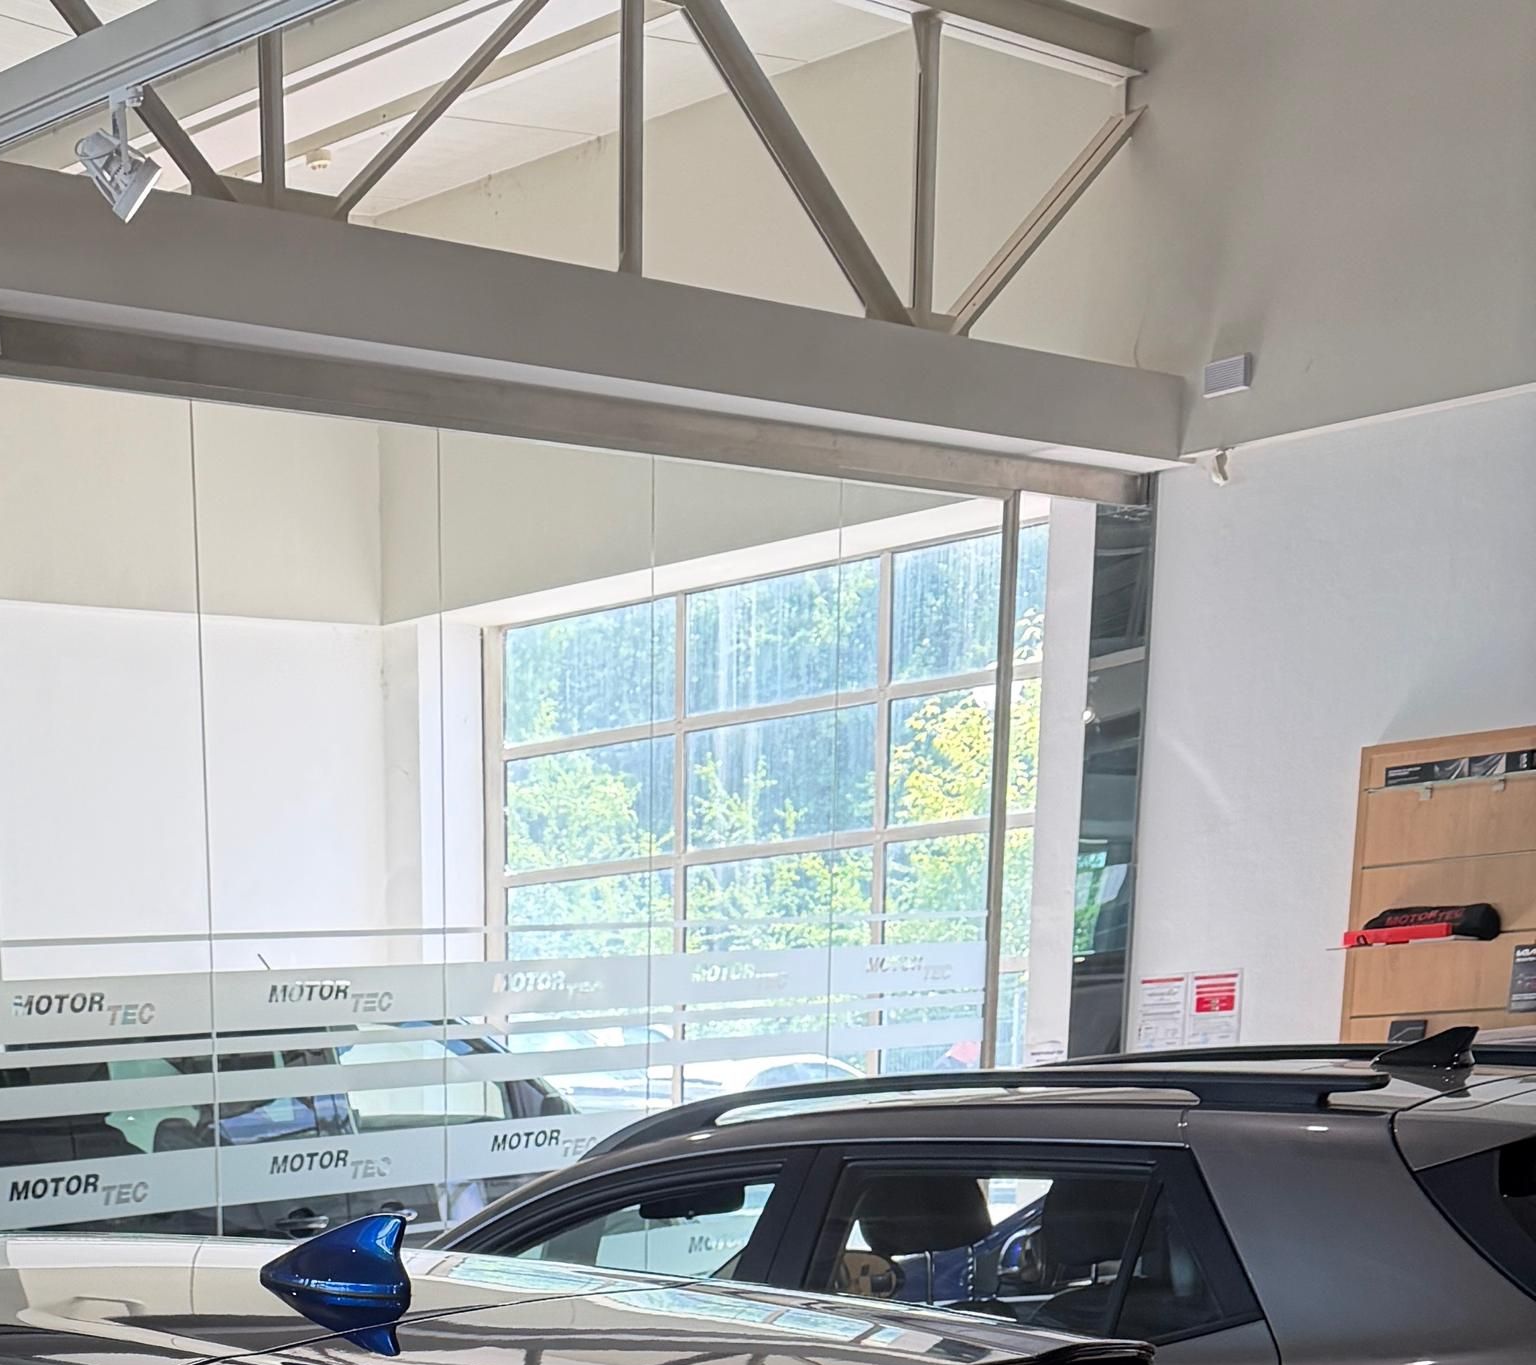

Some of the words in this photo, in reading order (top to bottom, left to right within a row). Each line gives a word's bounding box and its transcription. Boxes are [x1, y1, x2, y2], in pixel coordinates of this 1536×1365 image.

[492, 969, 567, 993] MOTOR
[13, 991, 105, 1017] MOTOR
[106, 1002, 155, 1026] TEC
[268, 980, 351, 1003] MOTOR
[351, 991, 393, 1013] TEC
[491, 1129, 561, 1153] MOTOR
[269, 1149, 349, 1175] MOTOR
[8, 1173, 100, 1202] MOTOR
[101, 1181, 149, 1206] TEC
